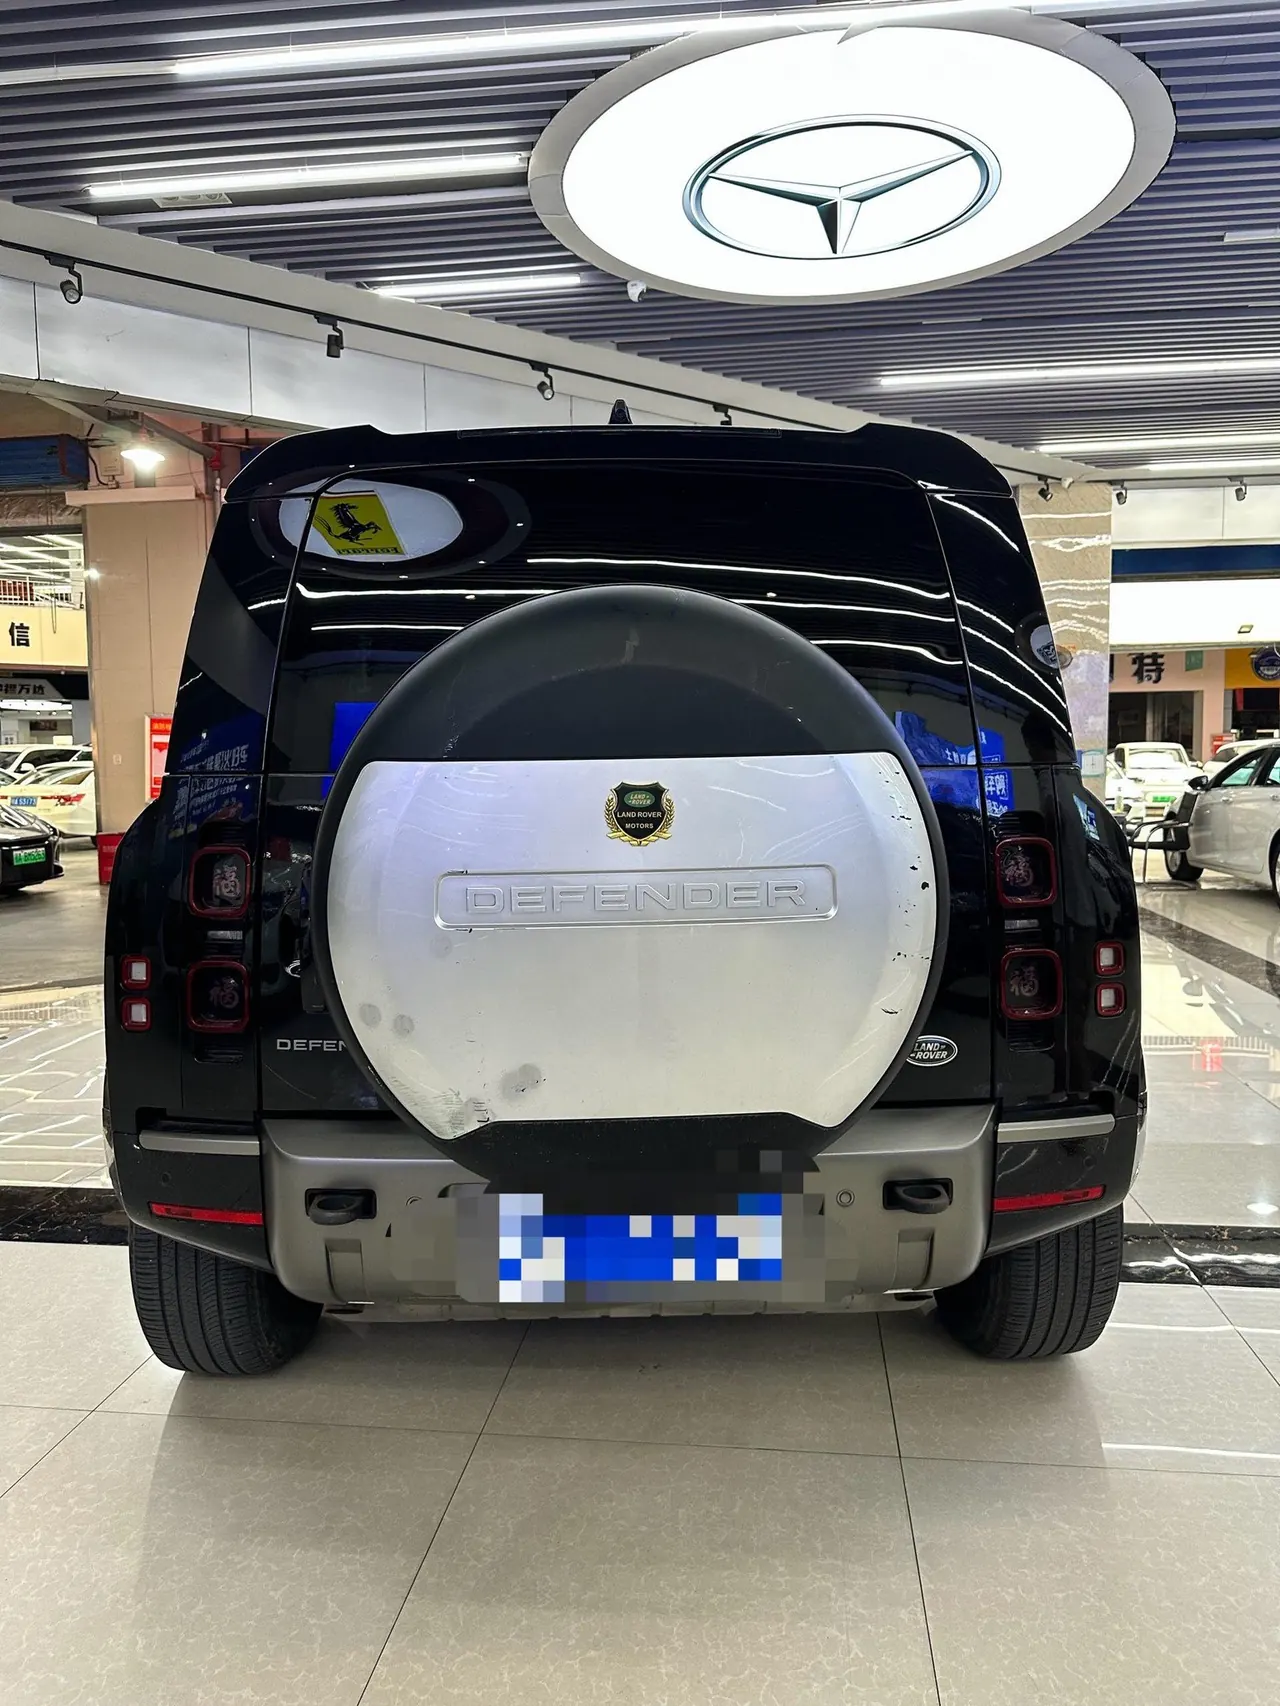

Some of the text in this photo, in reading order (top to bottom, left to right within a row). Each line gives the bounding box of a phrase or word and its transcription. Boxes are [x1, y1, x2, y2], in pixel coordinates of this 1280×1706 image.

[8, 622, 30, 647] 信
[465, 879, 806, 914] DEFENDER
[914, 1042, 940, 1051] LAND
[915, 1051, 948, 1059] ROVER
